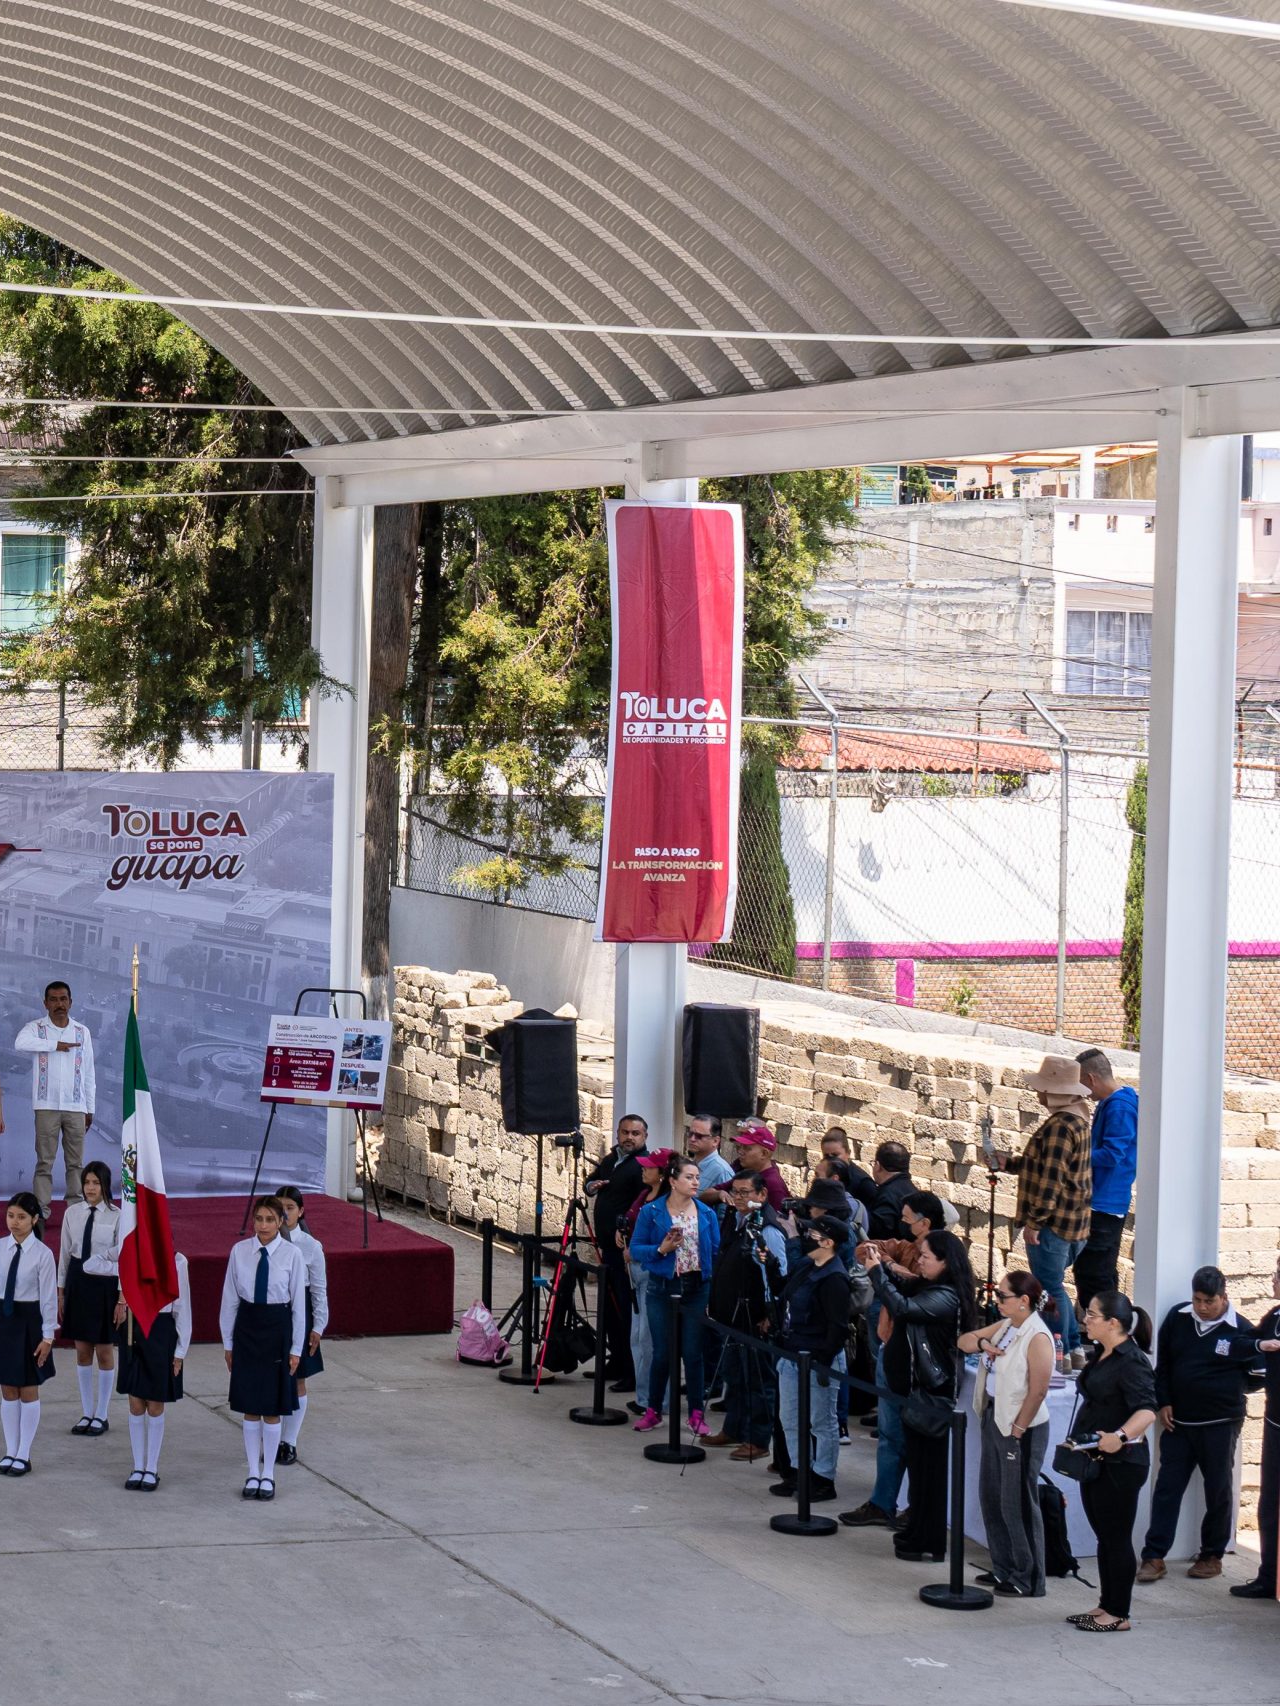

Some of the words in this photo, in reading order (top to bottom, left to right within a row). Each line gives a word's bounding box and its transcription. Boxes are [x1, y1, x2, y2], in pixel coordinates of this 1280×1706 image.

[620, 691, 727, 720] TOLUCA
[627, 724, 722, 735] CAPITAL
[103, 805, 248, 837] TOLUCA
[150, 841, 164, 850] se
[167, 840, 201, 852] pone
[634, 847, 660, 857] PASO
[661, 848, 670, 857] A
[671, 848, 700, 857] PASO
[612, 861, 626, 869] LA
[627, 860, 723, 870] TRANSFORMACIÓN
[106, 854, 245, 891] guapa
[643, 873, 686, 882] AVANZA
